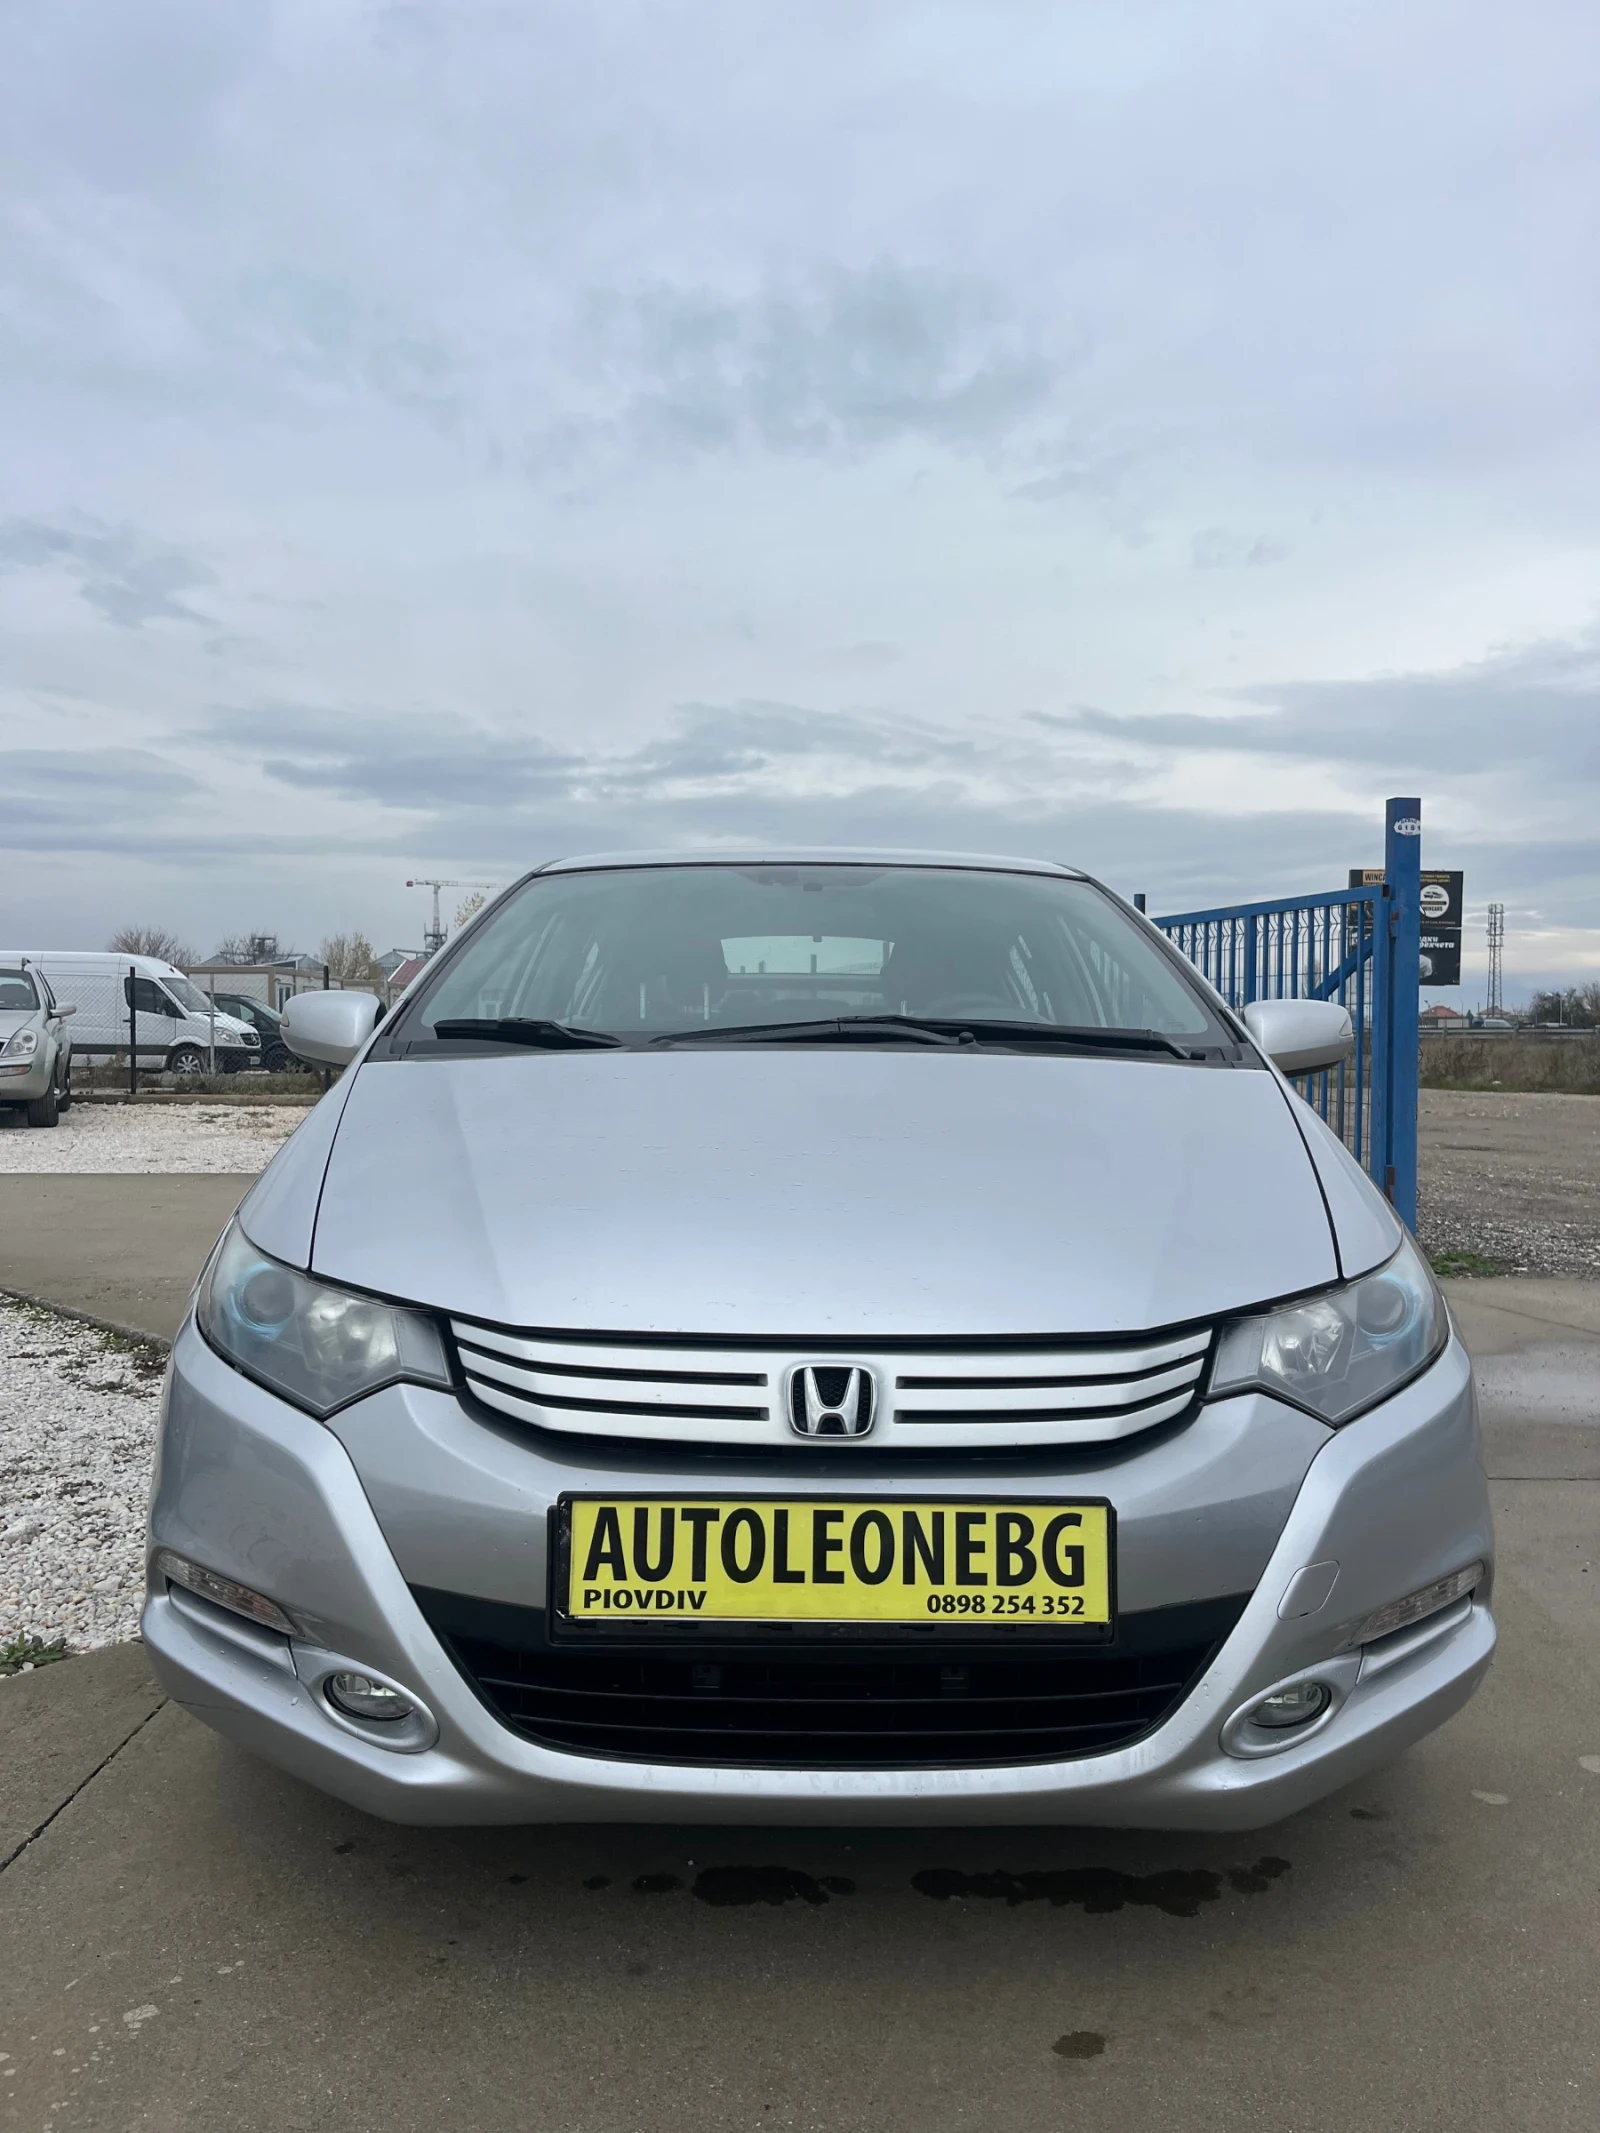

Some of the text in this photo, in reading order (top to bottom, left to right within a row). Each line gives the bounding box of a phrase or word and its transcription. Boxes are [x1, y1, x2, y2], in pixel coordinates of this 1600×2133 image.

[582, 1506, 1085, 1588] AUTOLEONEBG
[926, 1594, 1085, 1616] 0898 254 352
